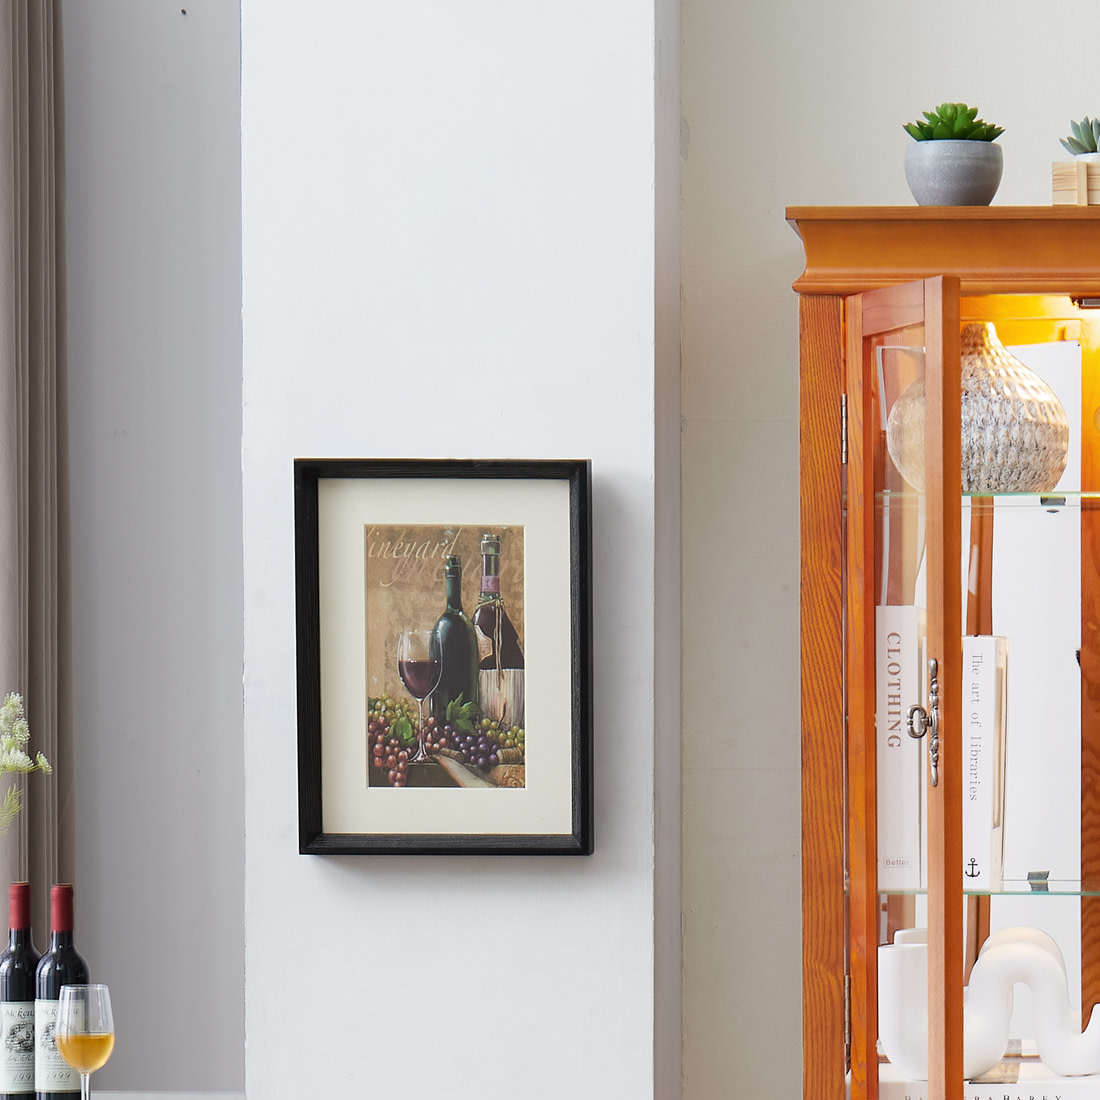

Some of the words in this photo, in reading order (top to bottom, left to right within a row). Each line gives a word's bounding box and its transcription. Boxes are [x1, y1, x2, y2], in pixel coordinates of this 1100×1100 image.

[367, 527, 463, 587] ineyard
[972, 653, 984, 675] The
[886, 631, 901, 749] CLOTHING
[971, 682, 980, 703] art
[970, 712, 982, 728] of
[969, 736, 982, 801] libraries
